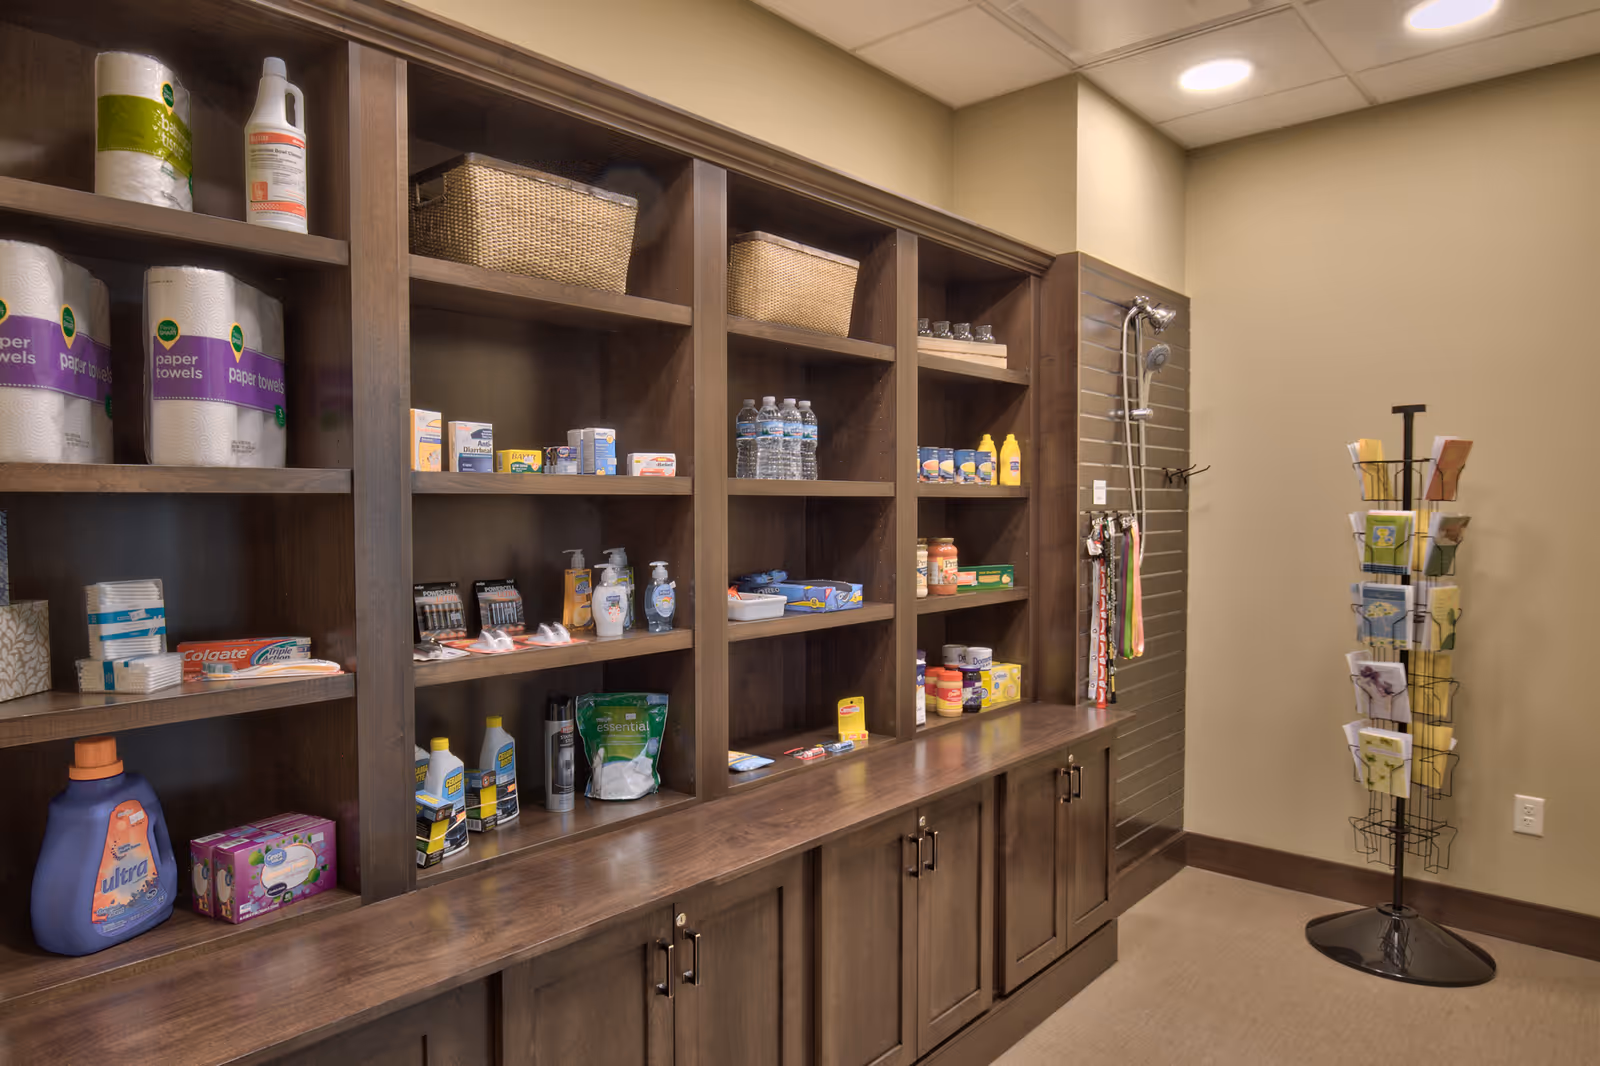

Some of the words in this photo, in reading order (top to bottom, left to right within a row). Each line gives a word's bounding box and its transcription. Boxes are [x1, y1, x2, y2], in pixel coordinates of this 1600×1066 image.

[156, 354, 198, 367] paper
[59, 352, 86, 374] paper
[88, 362, 112, 383] towels
[156, 367, 202, 379] towels
[229, 366, 256, 386] paper
[258, 373, 284, 394] towels
[423, 589, 456, 597] POWERCELL
[484, 585, 514, 593] POWERCELL
[497, 589, 517, 598] ULTRA
[183, 649, 247, 661] Colgate
[269, 646, 292, 656] Triple
[597, 720, 650, 732] essential
[101, 858, 148, 894] ultra
